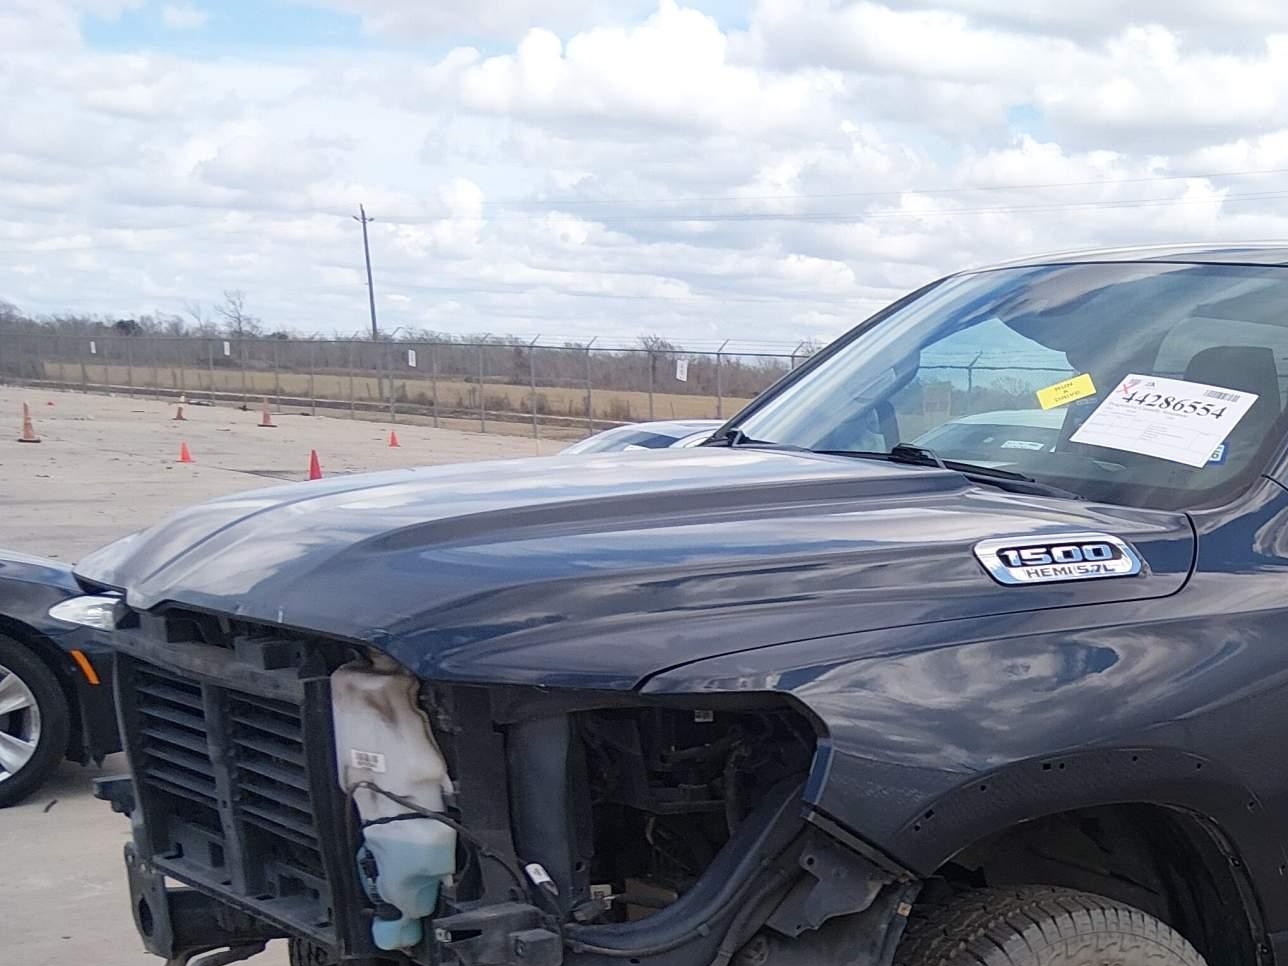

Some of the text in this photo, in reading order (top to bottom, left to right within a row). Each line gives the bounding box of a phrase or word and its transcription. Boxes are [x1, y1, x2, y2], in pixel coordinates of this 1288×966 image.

[1122, 390, 1228, 420] 44286554
[1000, 544, 1113, 567] 1500
[1026, 563, 1116, 579] HEMI 5.7L
